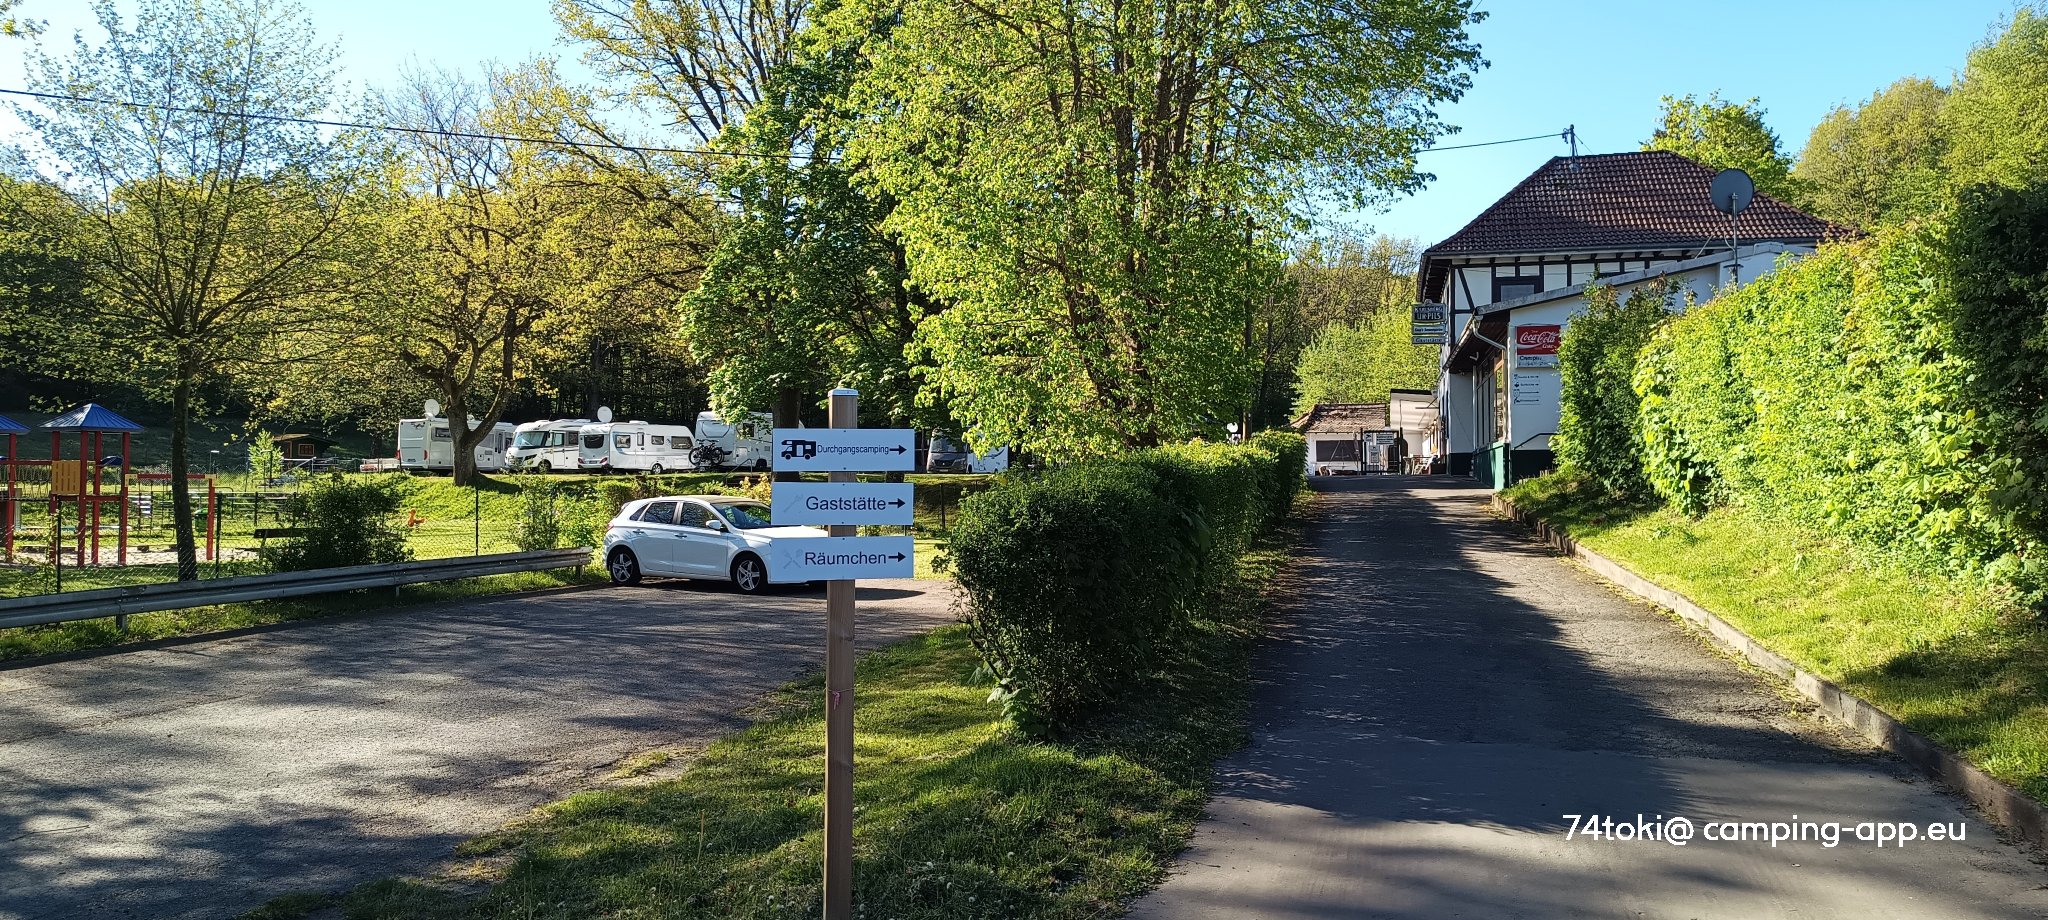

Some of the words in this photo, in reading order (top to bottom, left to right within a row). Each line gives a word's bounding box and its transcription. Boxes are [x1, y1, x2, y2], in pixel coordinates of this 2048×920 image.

[817, 444, 889, 456] Durchgangscamping
[805, 496, 886, 511] Gaststätte
[805, 551, 886, 566] Räumchen
